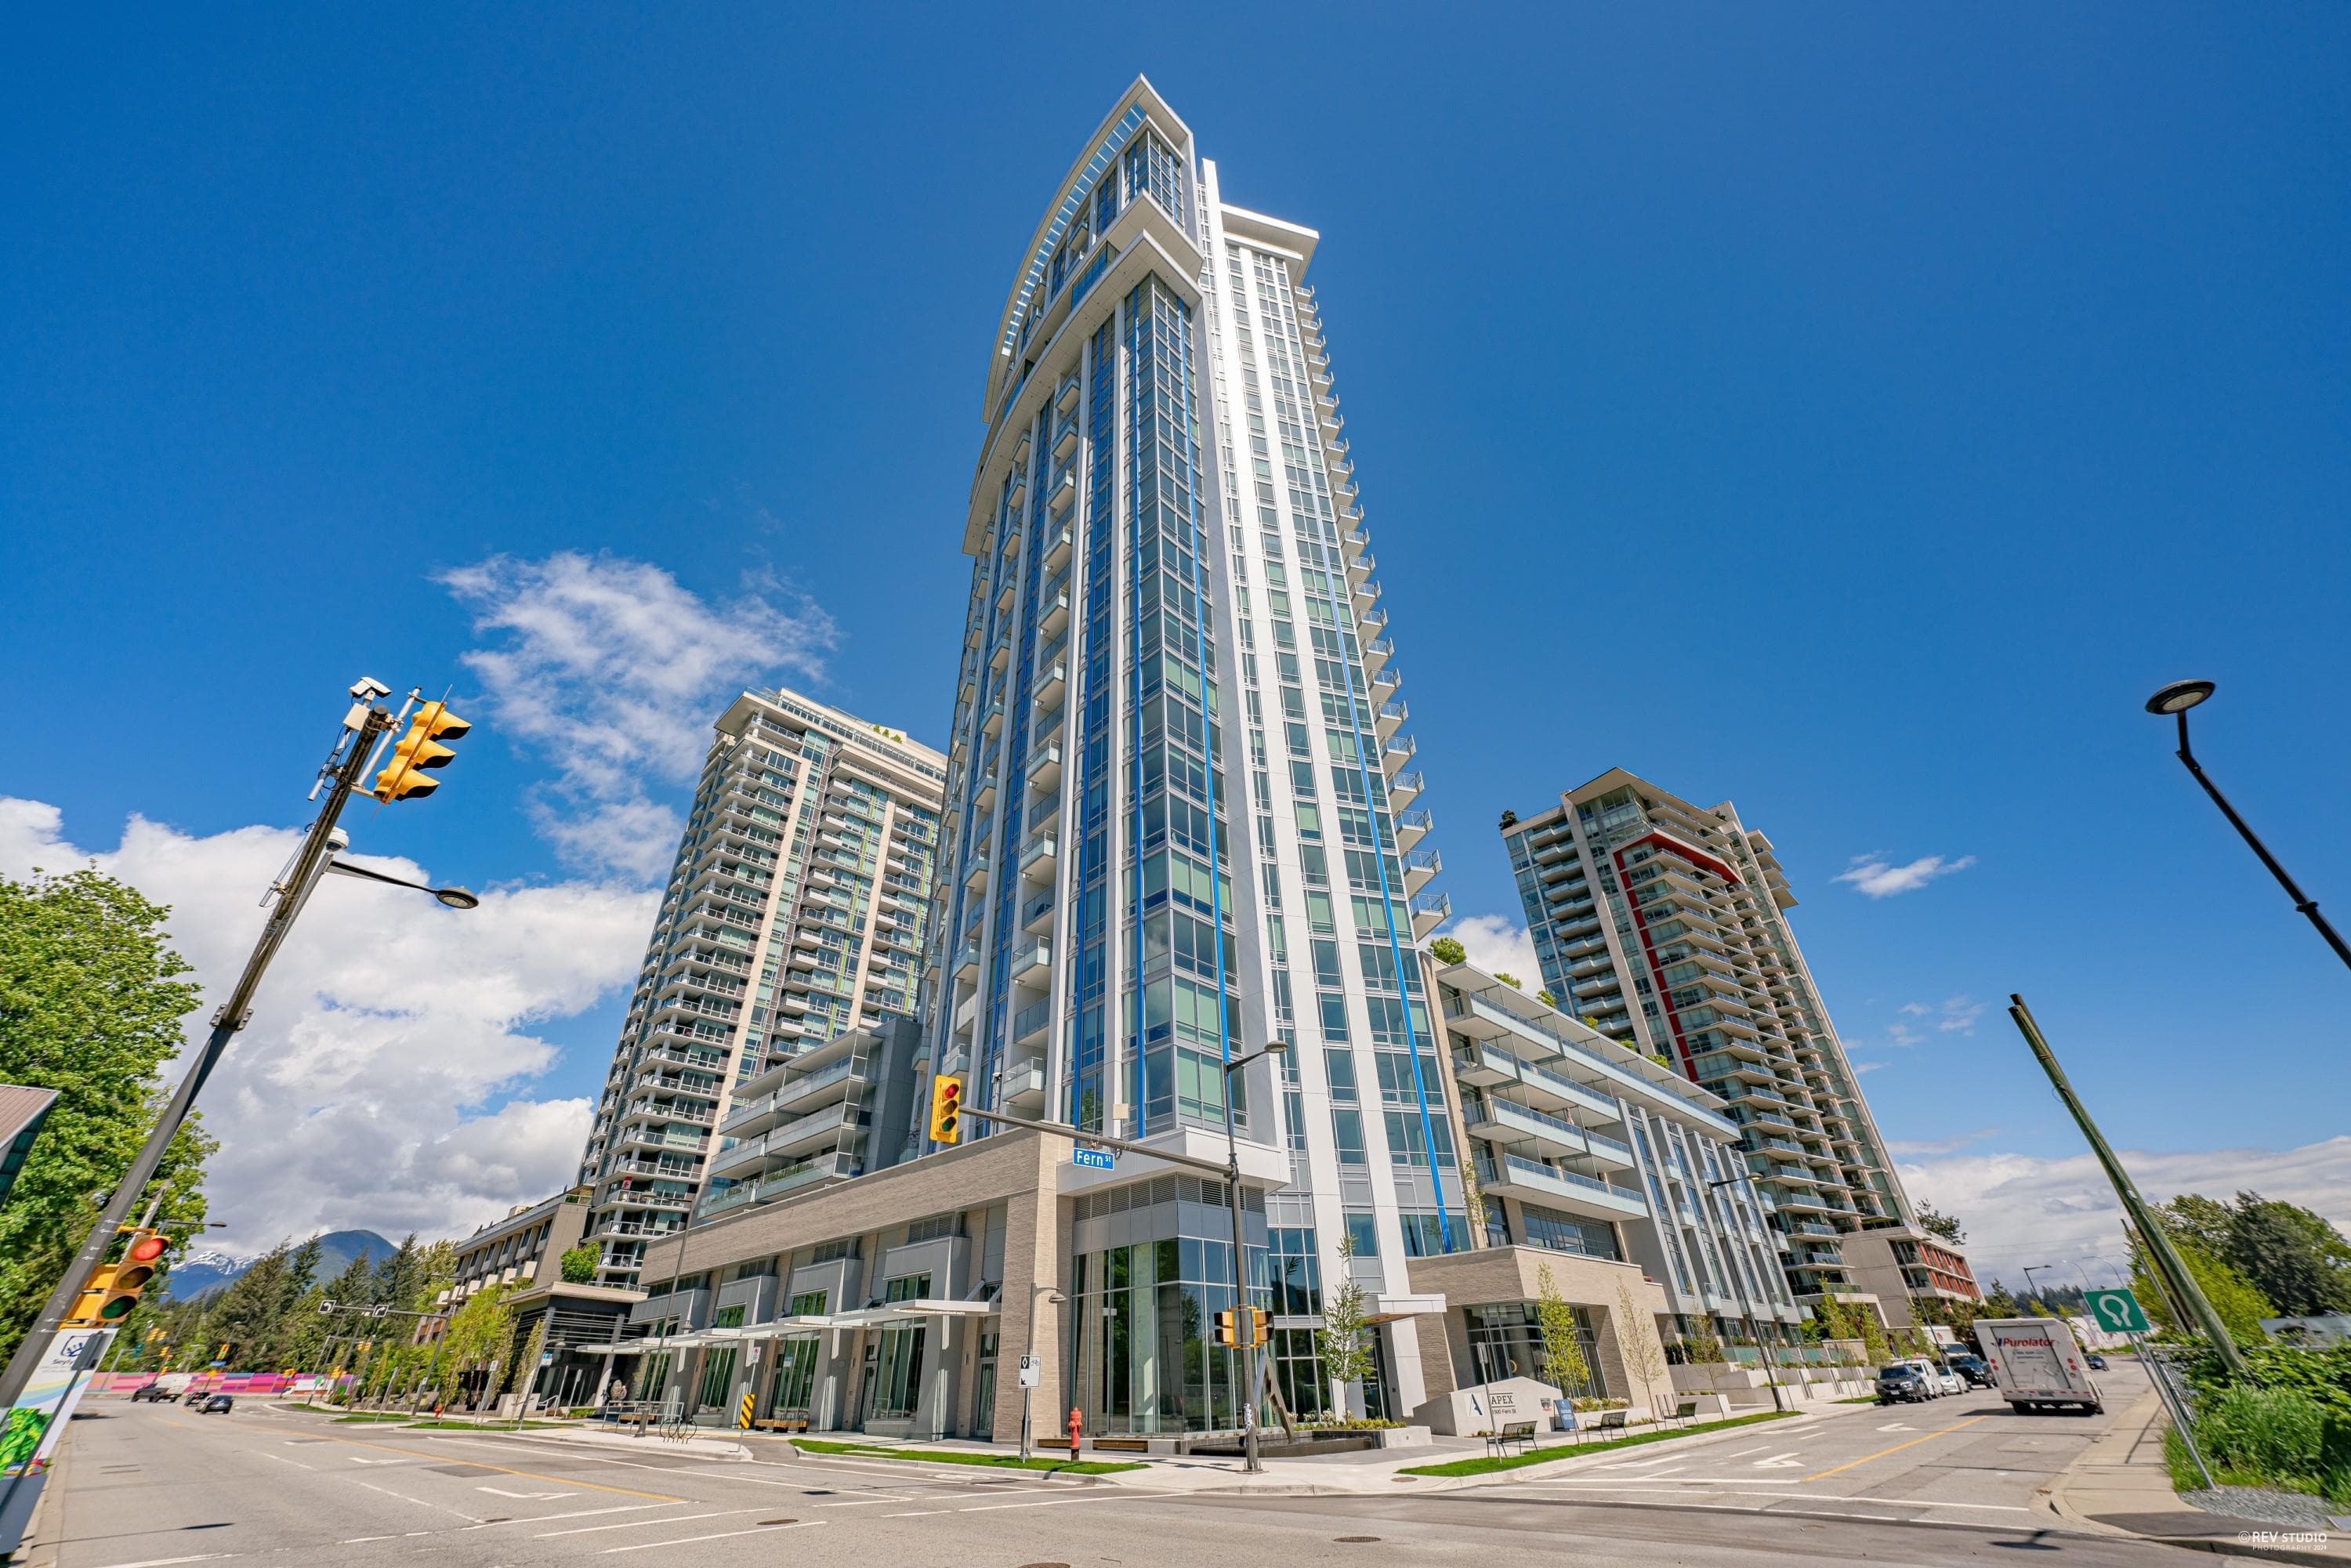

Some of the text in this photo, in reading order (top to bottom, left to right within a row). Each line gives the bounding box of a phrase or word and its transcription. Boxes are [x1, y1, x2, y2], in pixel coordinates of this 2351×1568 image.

[1077, 1150, 1103, 1167] Fern
[2003, 1338, 2056, 1347] Purolator
[1491, 1395, 1514, 1405] APEX
